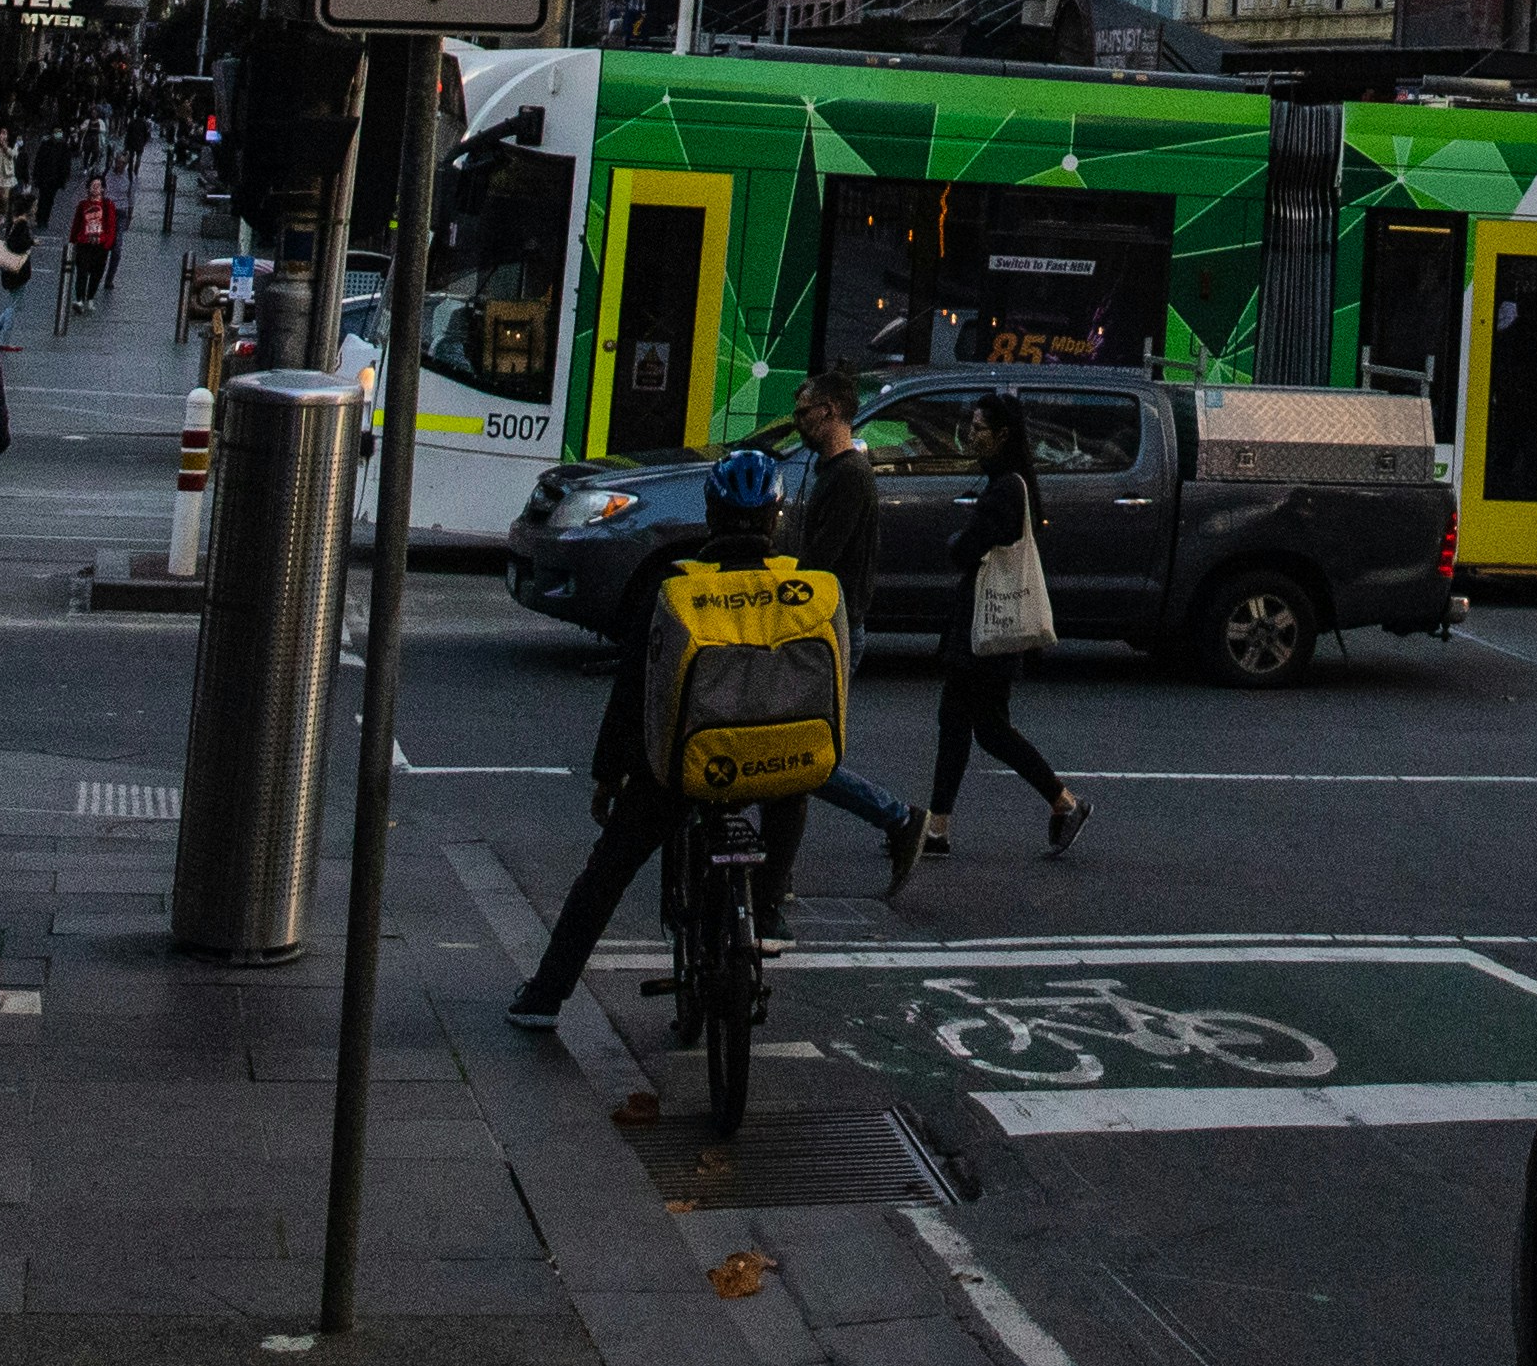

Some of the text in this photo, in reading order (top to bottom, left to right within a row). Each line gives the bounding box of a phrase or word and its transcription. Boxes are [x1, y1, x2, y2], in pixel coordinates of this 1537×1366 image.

[20, 12, 86, 28] MYER
[994, 258, 1093, 272] Switch to Fast NBN
[987, 332, 1046, 365] 85
[486, 412, 551, 442] 5007
[985, 588, 1031, 601] Between
[985, 600, 1003, 613] the
